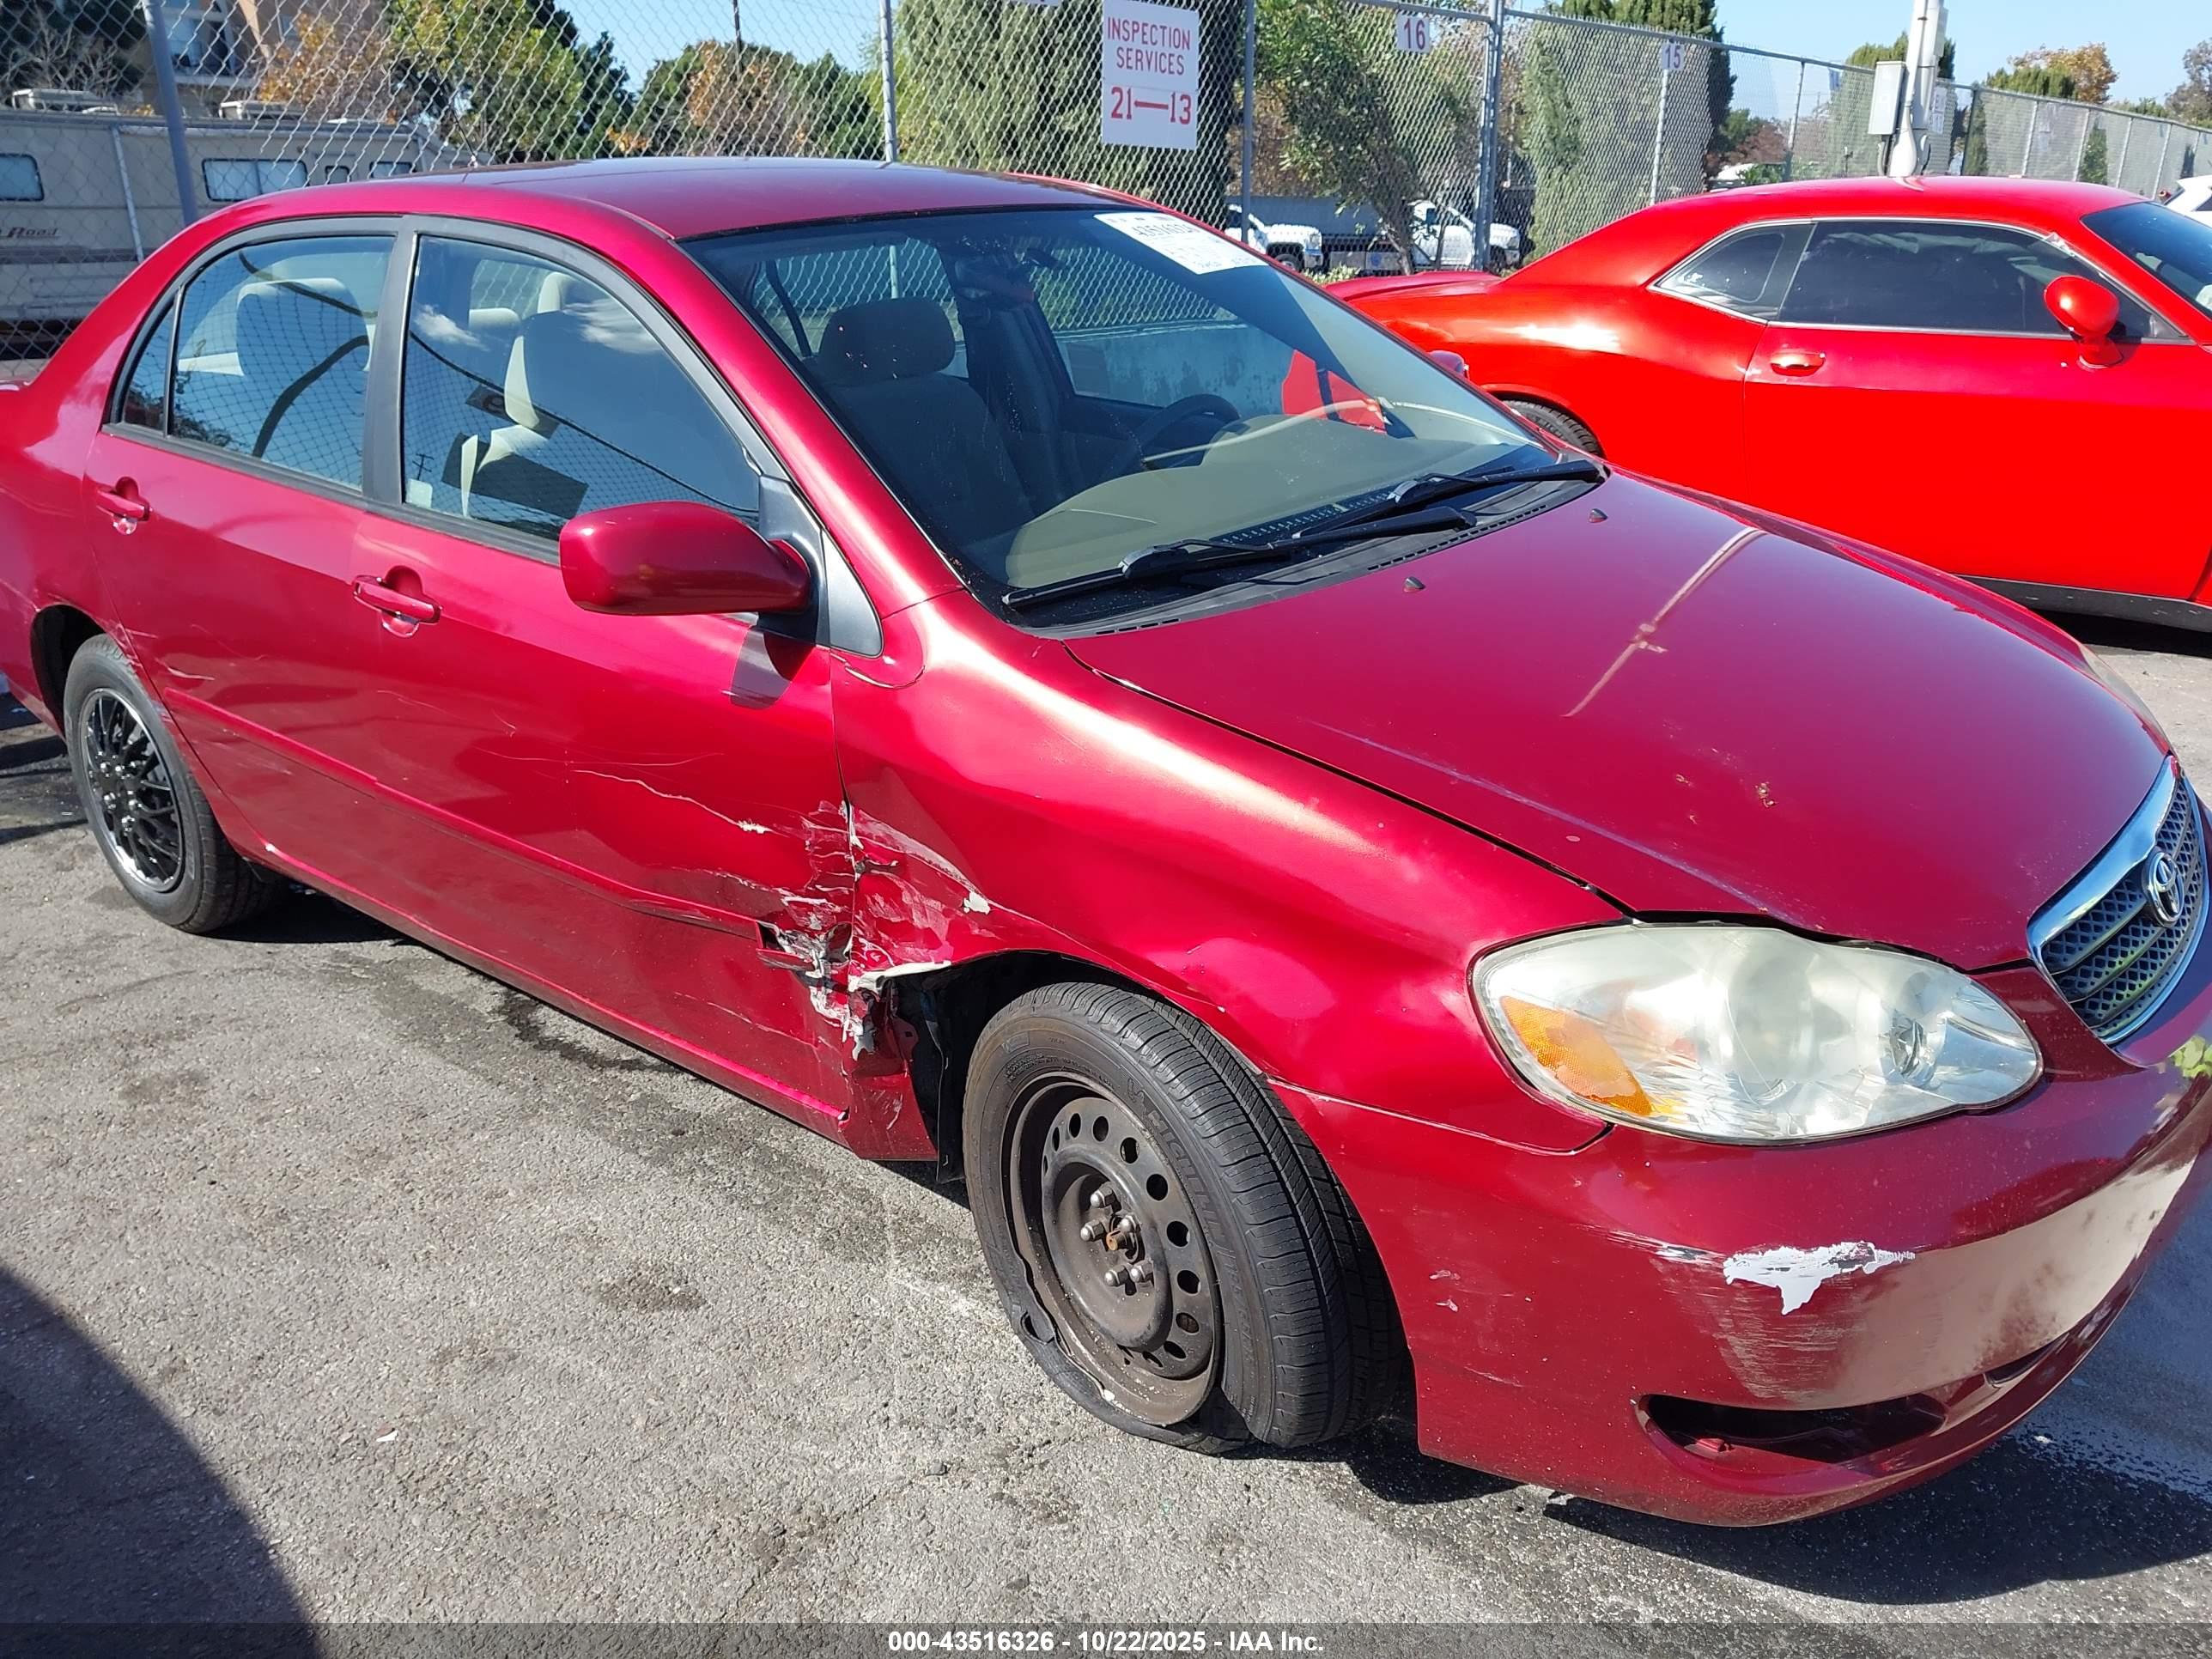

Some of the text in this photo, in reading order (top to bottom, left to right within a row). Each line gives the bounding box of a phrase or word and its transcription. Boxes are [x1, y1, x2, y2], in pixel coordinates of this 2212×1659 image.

[1108, 16, 1190, 51] INSPECTION
[1403, 17, 1425, 50] 16
[1116, 46, 1184, 76] SERVICES
[1665, 45, 1680, 69] 15
